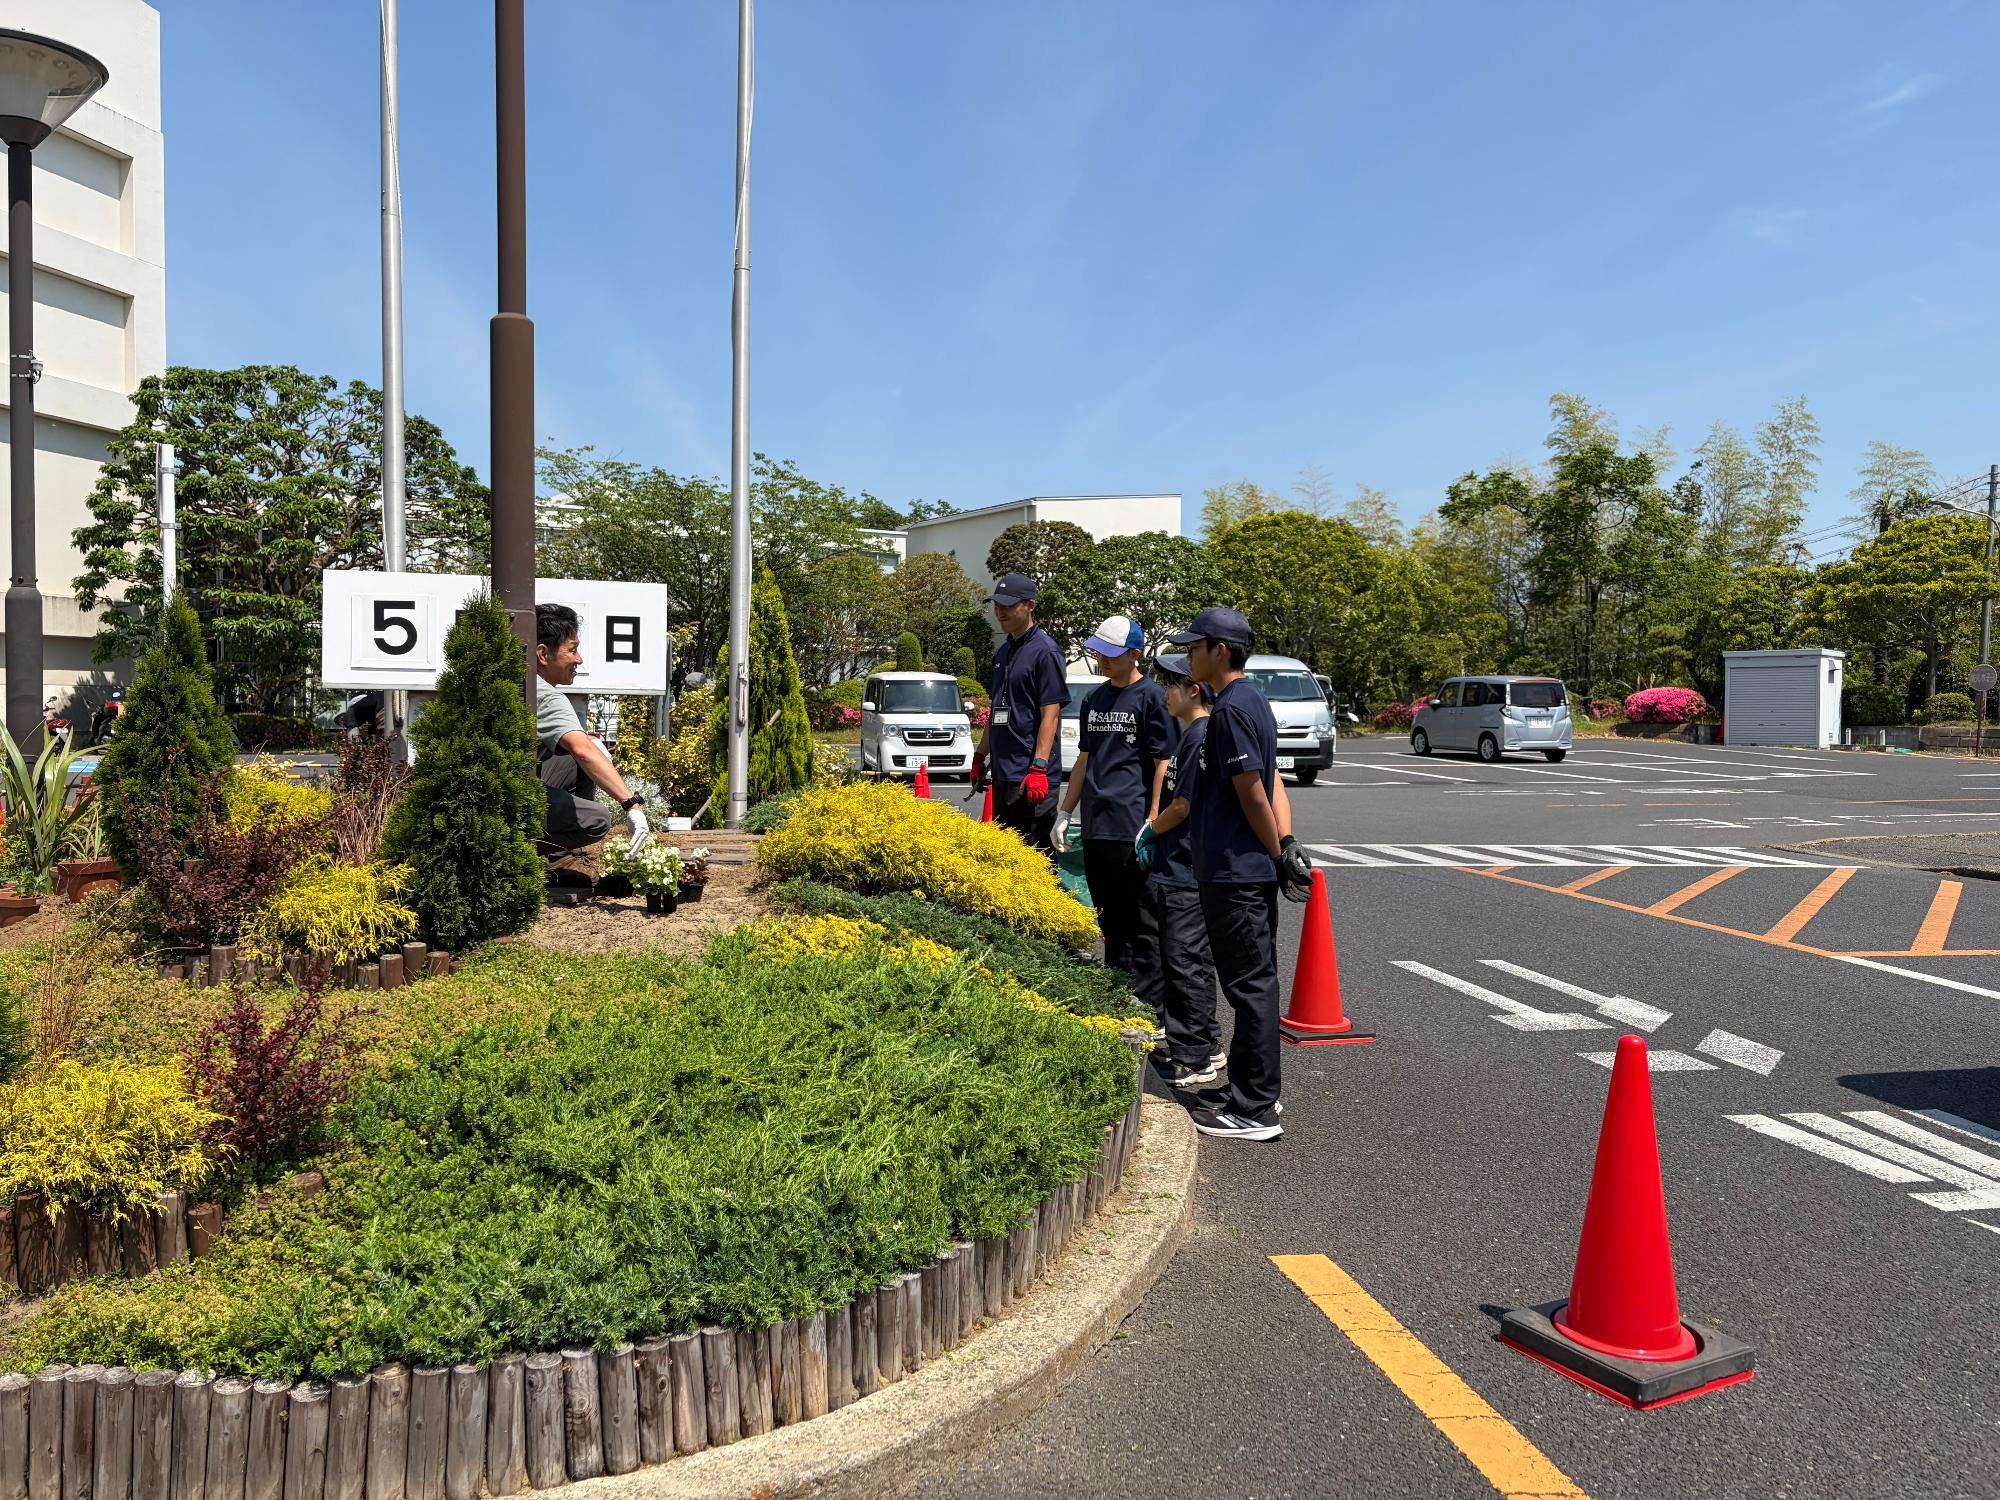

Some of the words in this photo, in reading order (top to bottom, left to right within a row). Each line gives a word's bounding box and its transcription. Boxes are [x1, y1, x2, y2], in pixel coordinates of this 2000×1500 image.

[374, 600, 417, 655] 5
[606, 616, 640, 663] 日
[1097, 711, 1136, 724] SAKURA
